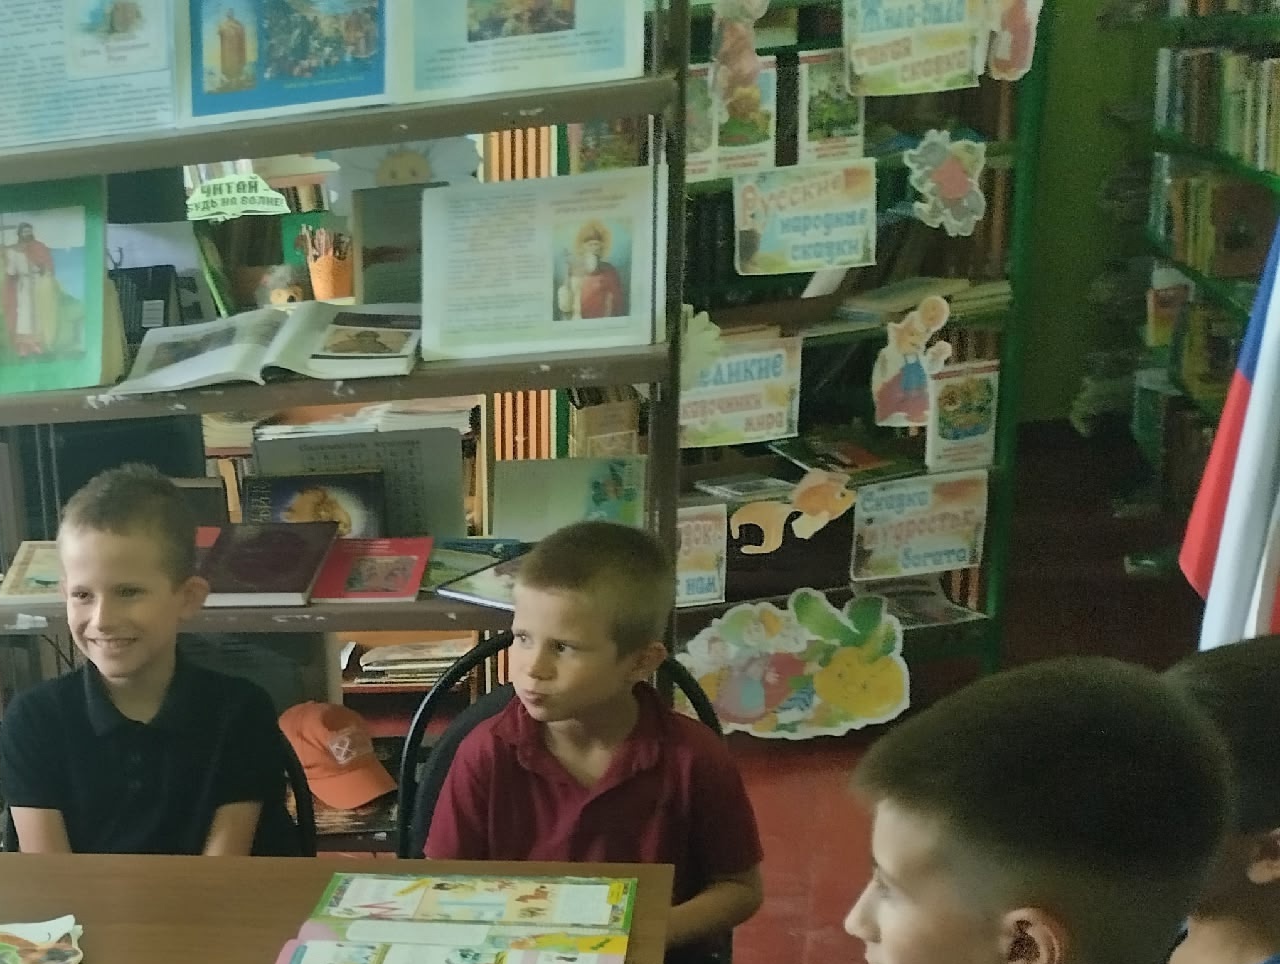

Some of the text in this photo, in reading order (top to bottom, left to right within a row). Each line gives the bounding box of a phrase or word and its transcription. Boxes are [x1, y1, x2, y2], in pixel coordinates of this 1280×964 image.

[200, 175, 259, 197] ЧИТАЙ
[741, 172, 843, 232] Русские
[780, 207, 868, 236] народные
[699, 352, 784, 387] еликие
